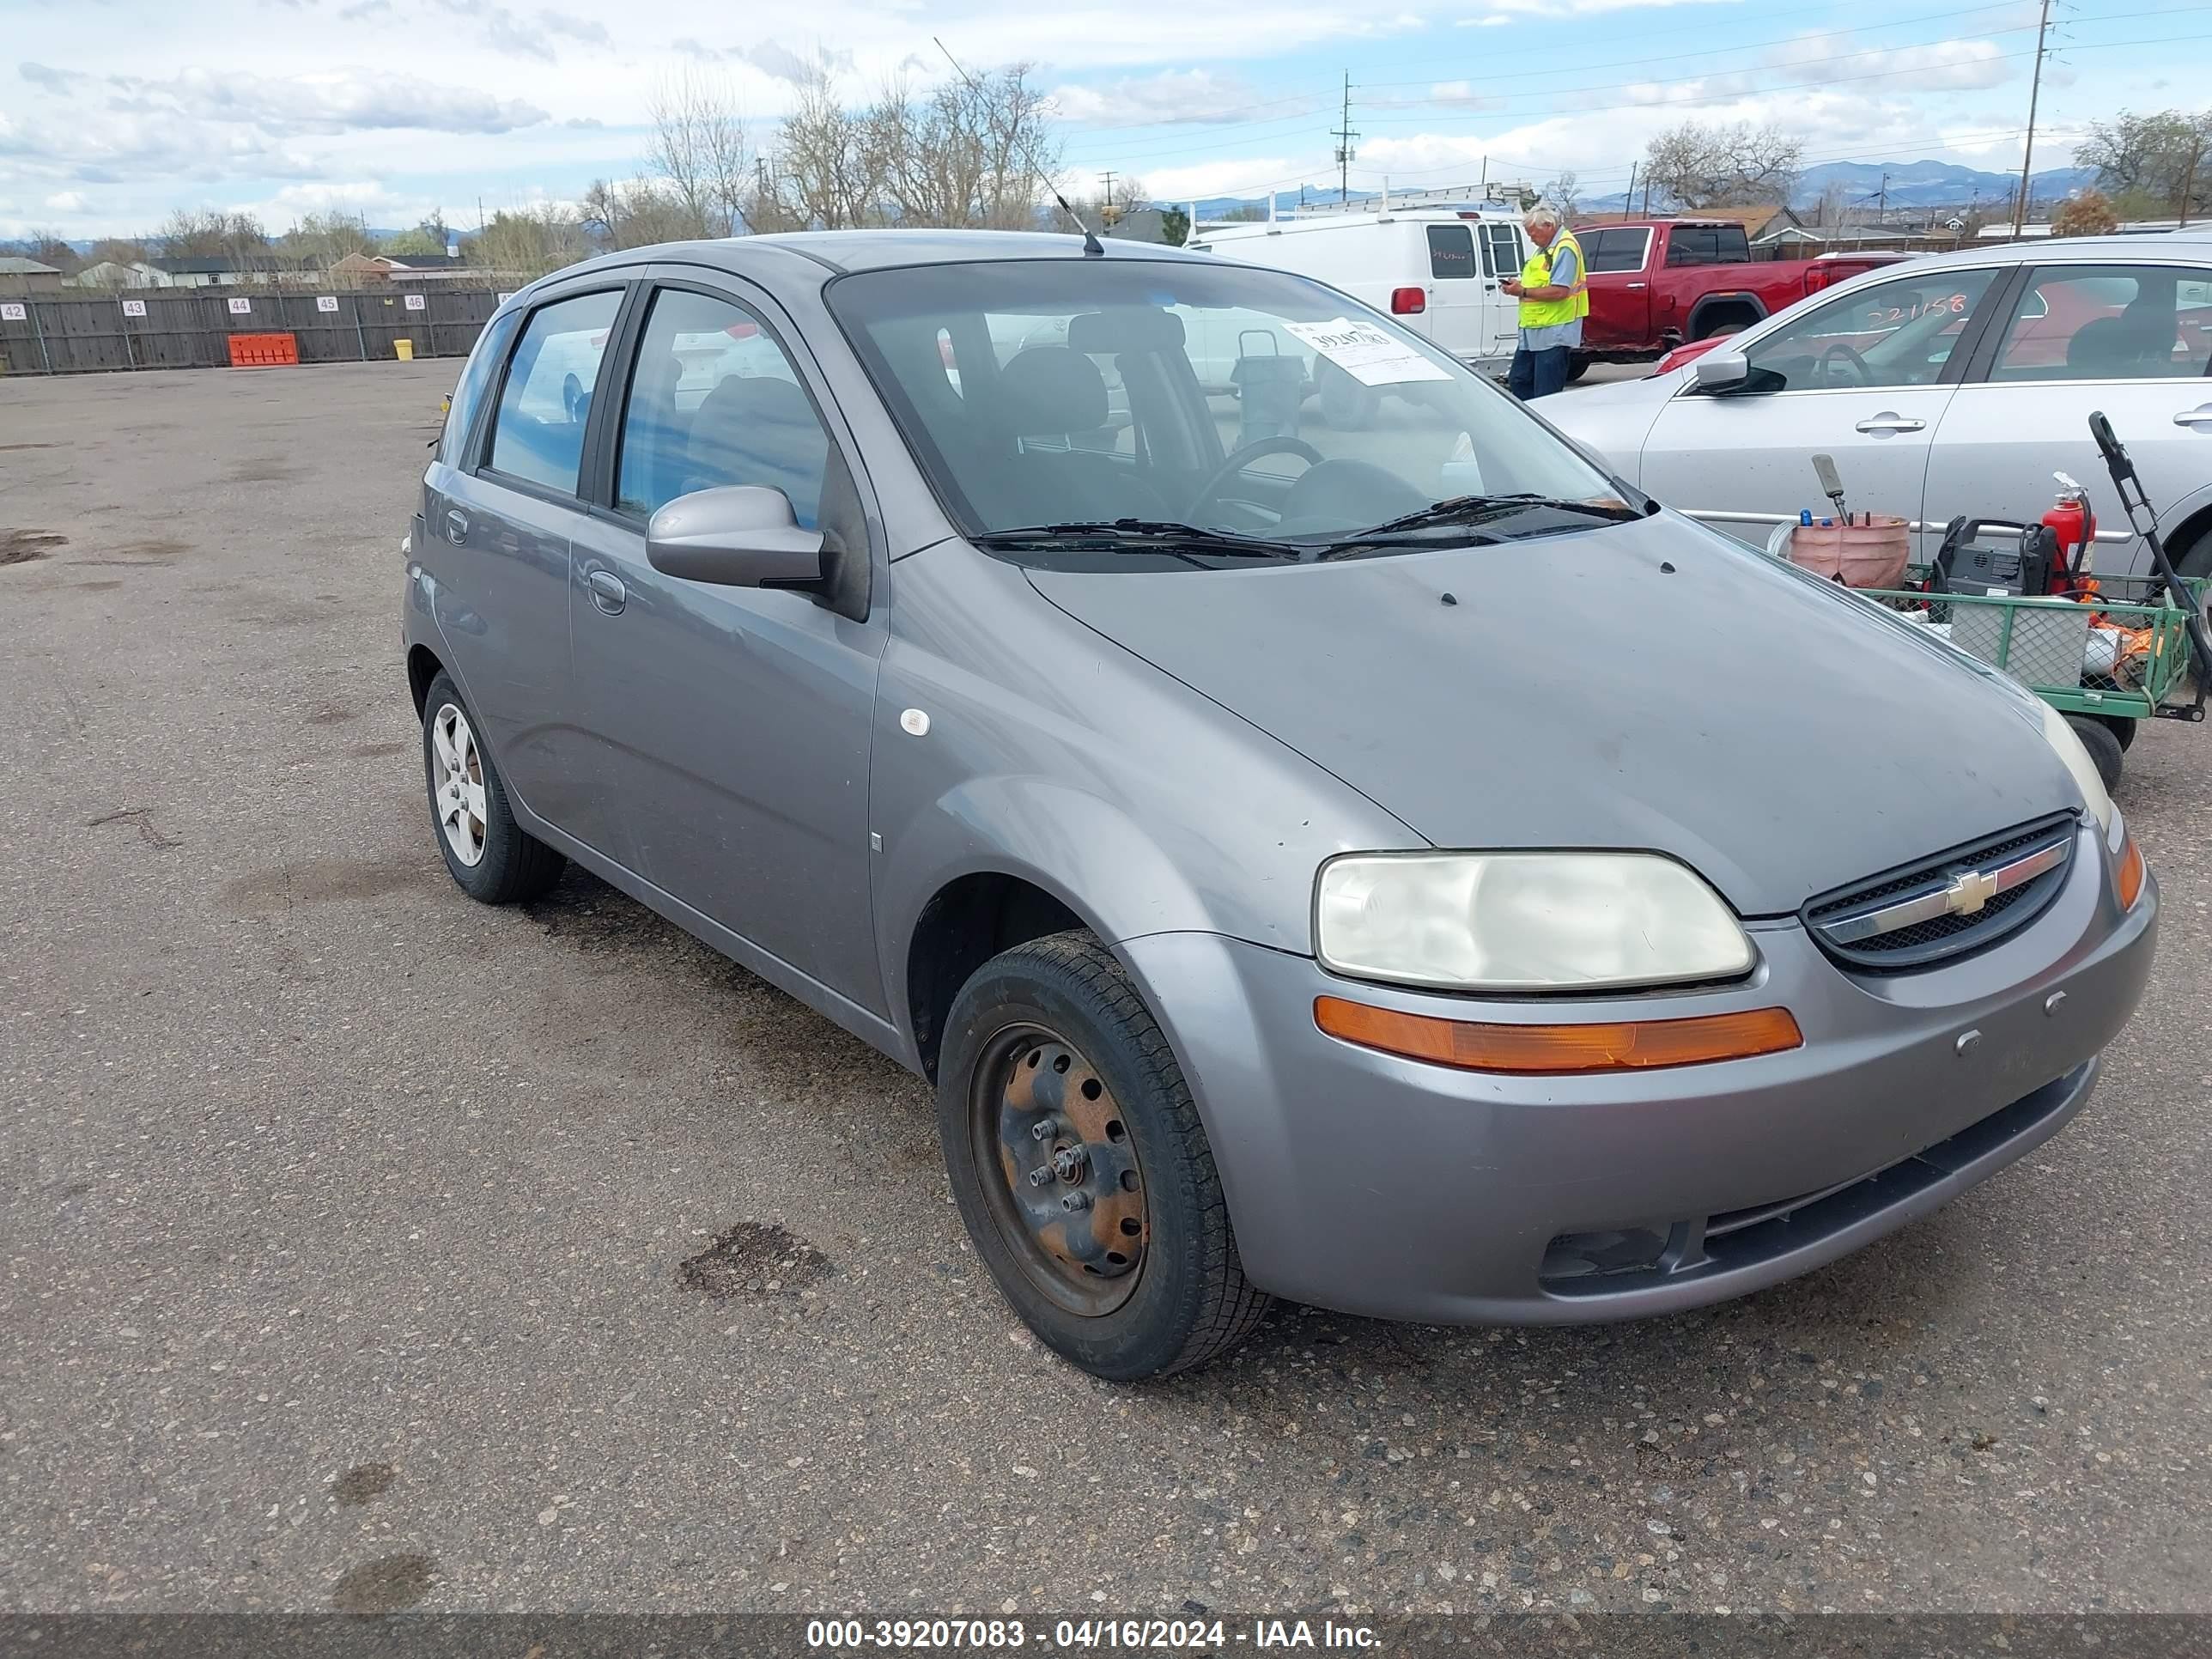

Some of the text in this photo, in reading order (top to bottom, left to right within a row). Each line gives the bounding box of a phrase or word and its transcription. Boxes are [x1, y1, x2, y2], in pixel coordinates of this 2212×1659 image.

[233, 300, 246, 310] 44
[321, 299, 335, 309] 45
[408, 296, 422, 307] 46
[5, 306, 21, 317] 42
[127, 302, 142, 314] 43
